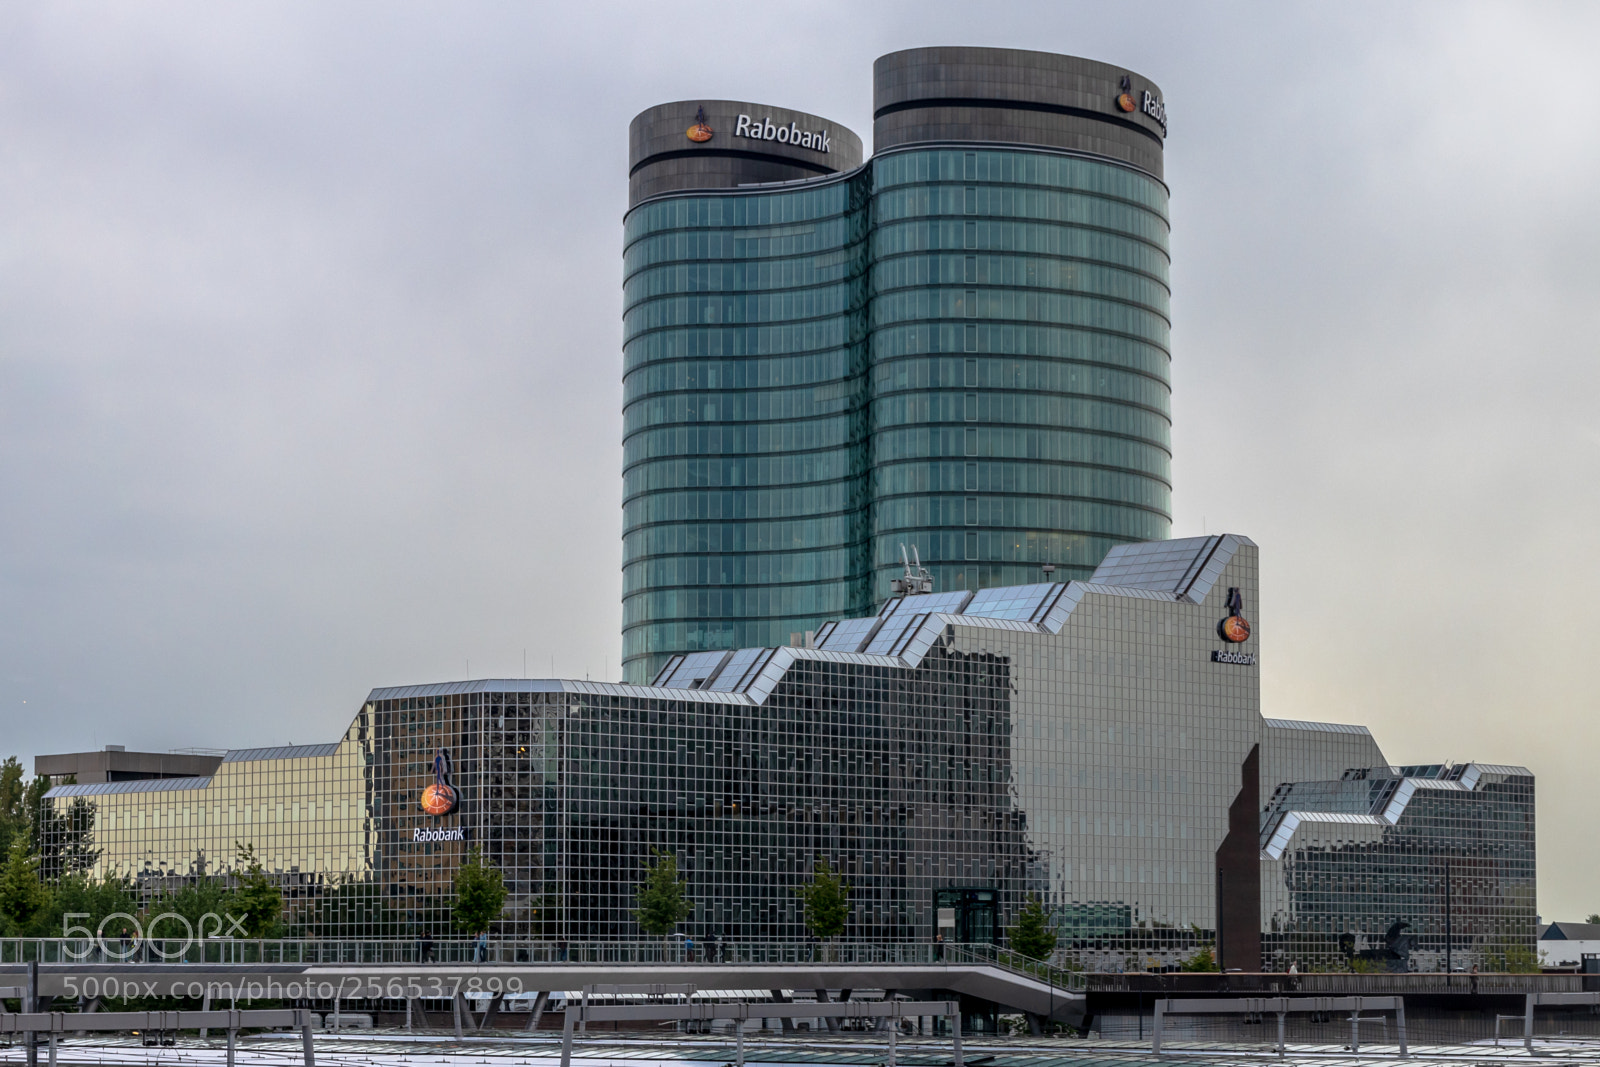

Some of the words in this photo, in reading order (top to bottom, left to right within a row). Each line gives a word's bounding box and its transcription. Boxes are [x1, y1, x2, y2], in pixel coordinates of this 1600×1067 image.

[735, 114, 831, 153] Rabobank
[1217, 650, 1256, 666] Rabobank
[413, 826, 465, 842] Rabobank
